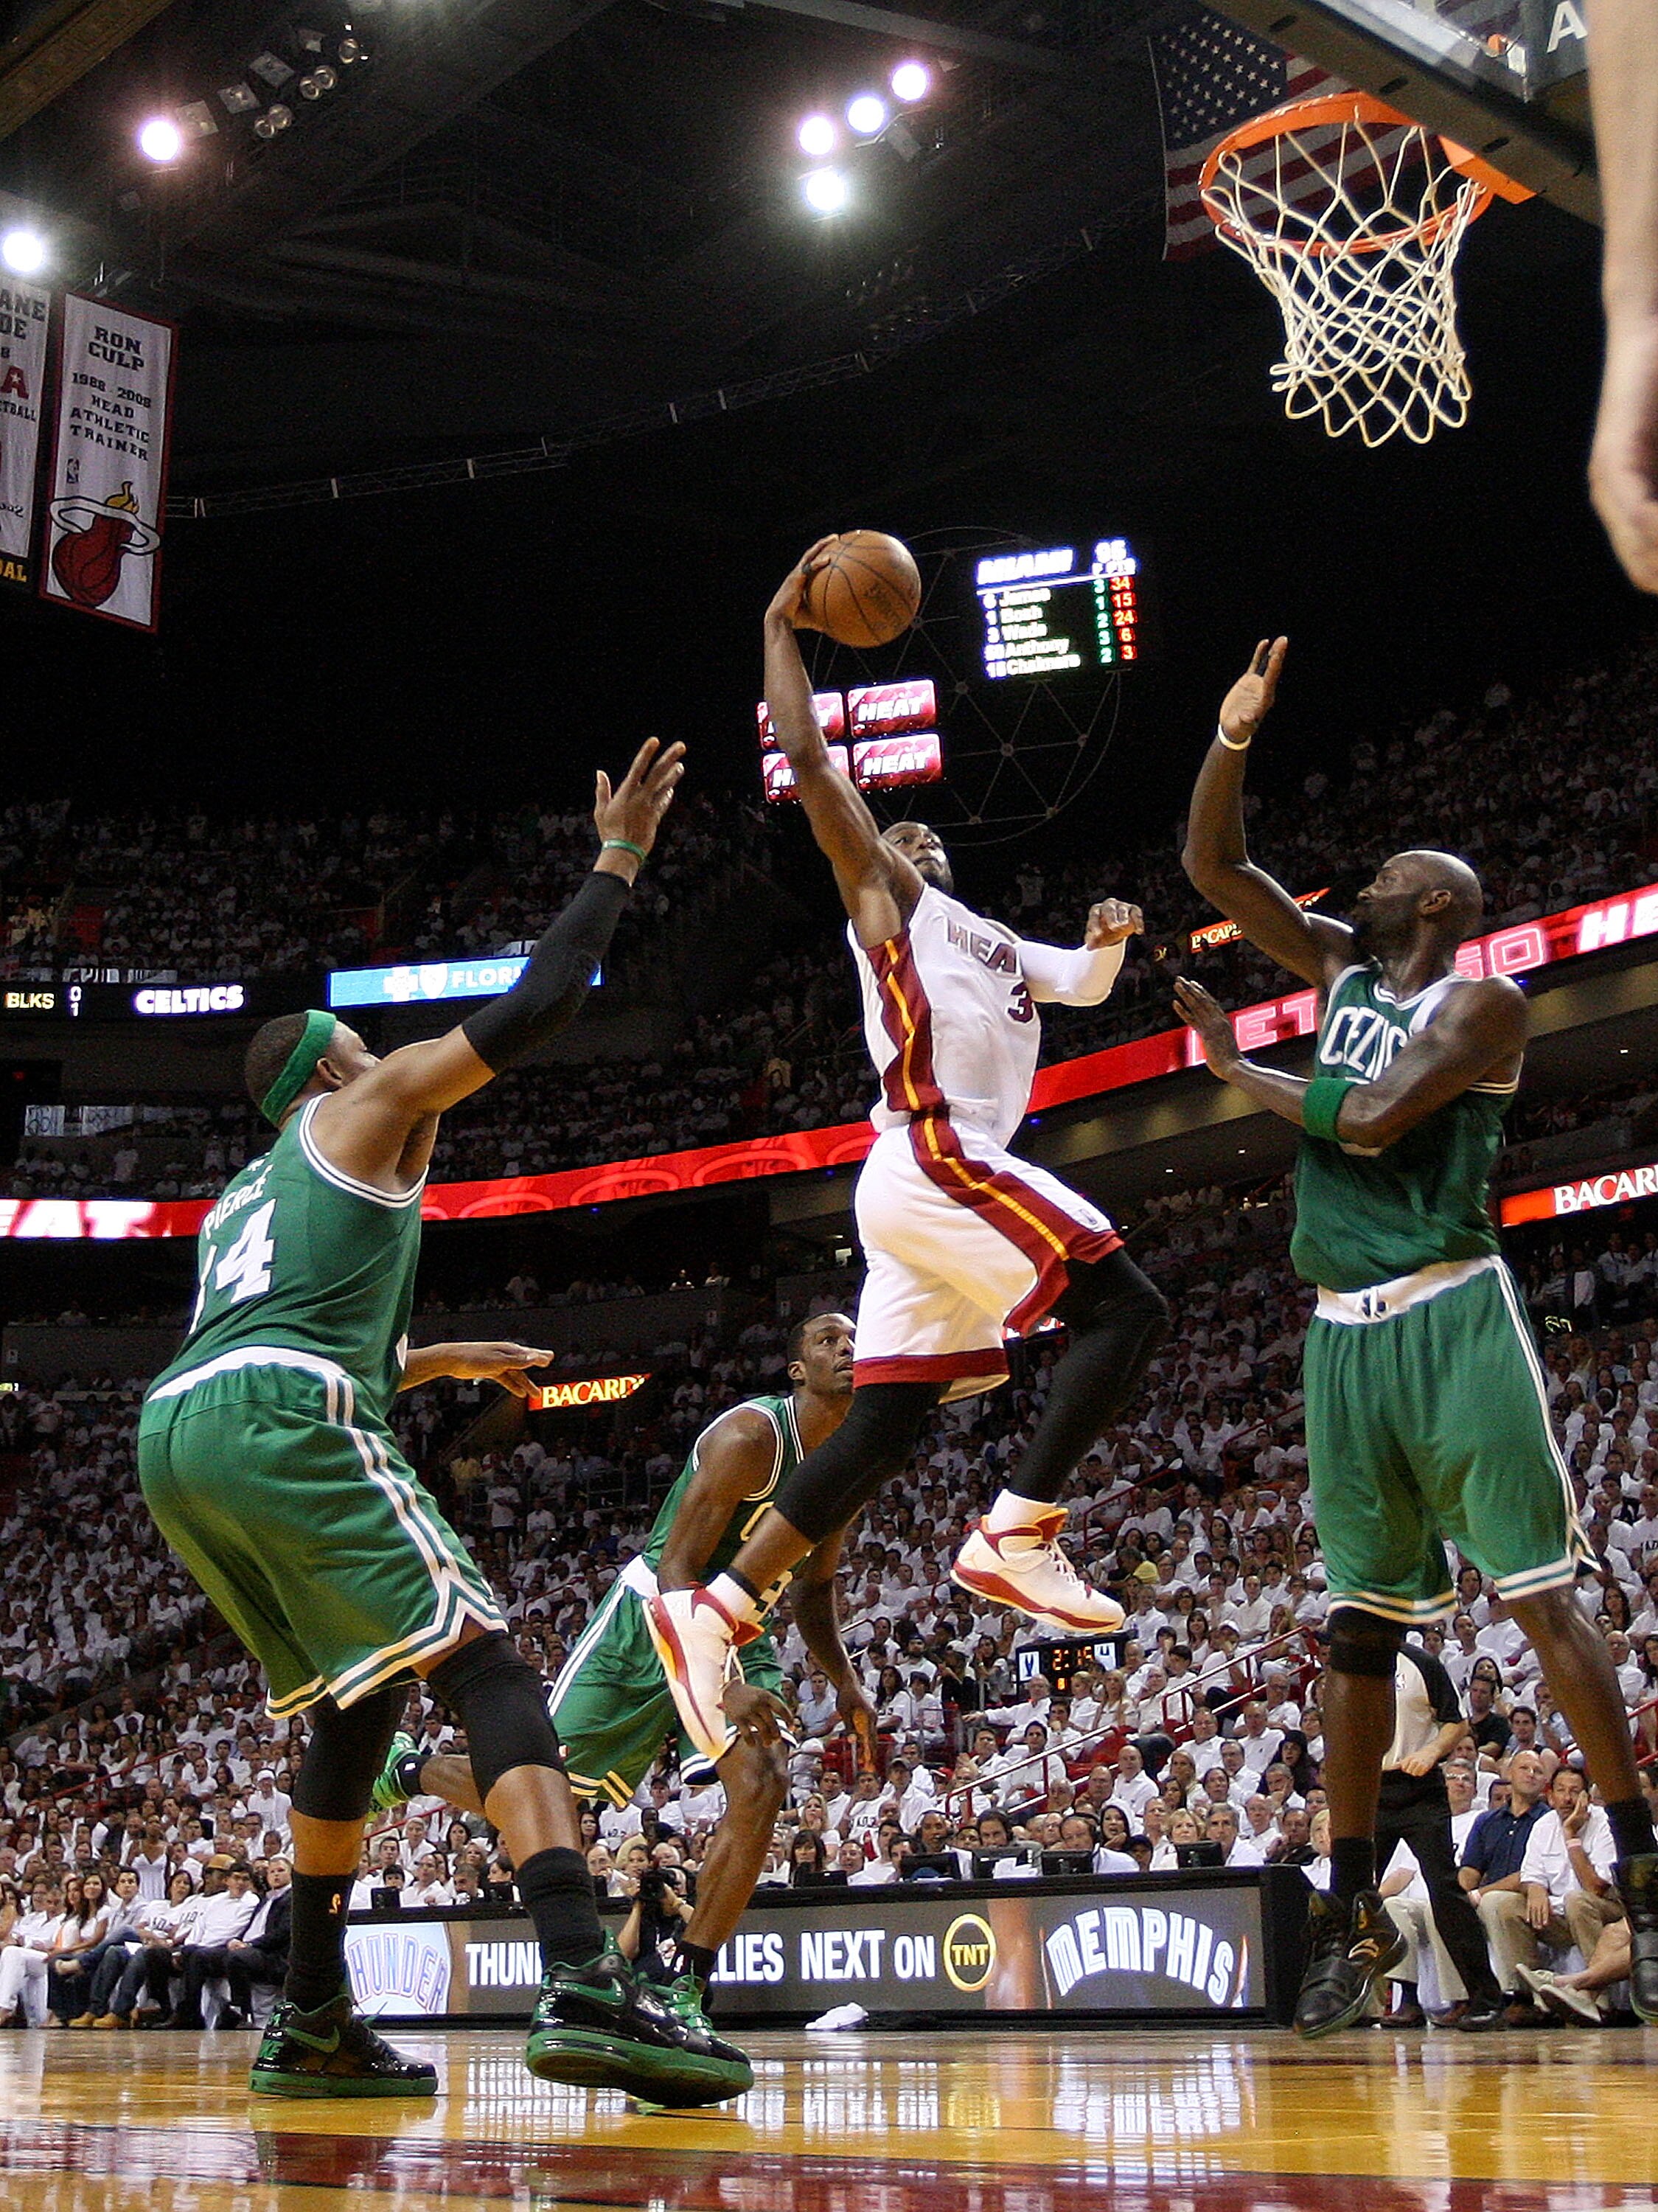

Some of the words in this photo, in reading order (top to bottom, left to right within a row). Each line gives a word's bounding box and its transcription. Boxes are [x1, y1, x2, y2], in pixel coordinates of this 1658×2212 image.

[94, 326, 142, 355] RON
[88, 342, 144, 372] CULP
[91, 394, 134, 418] HEAD
[70, 407, 149, 442] ATHLETIC
[70, 425, 148, 462] TRAINER
[1094, 578, 1105, 594] 3
[1110, 577, 1131, 591] 34
[1112, 593, 1132, 608] 15
[1097, 613, 1109, 628] 2
[1114, 611, 1135, 625] 24
[1099, 630, 1110, 645] 3
[1121, 627, 1132, 641] 6
[1100, 647, 1112, 663] 2
[1122, 645, 1134, 659] 3
[857, 692, 928, 722] HEAT
[863, 745, 934, 776] HEAT
[7, 992, 55, 1009] BLKS
[136, 984, 245, 1015] CELTICS
[1008, 981, 1034, 1023] 3
[1554, 1164, 1658, 1215] BACAR
[709, 1933, 784, 1982] LIES
[801, 1930, 885, 1980] NEXT
[894, 1935, 936, 1979] ON
[951, 1944, 989, 1966] TNT
[1045, 1906, 1234, 2006] MEMPHIS
